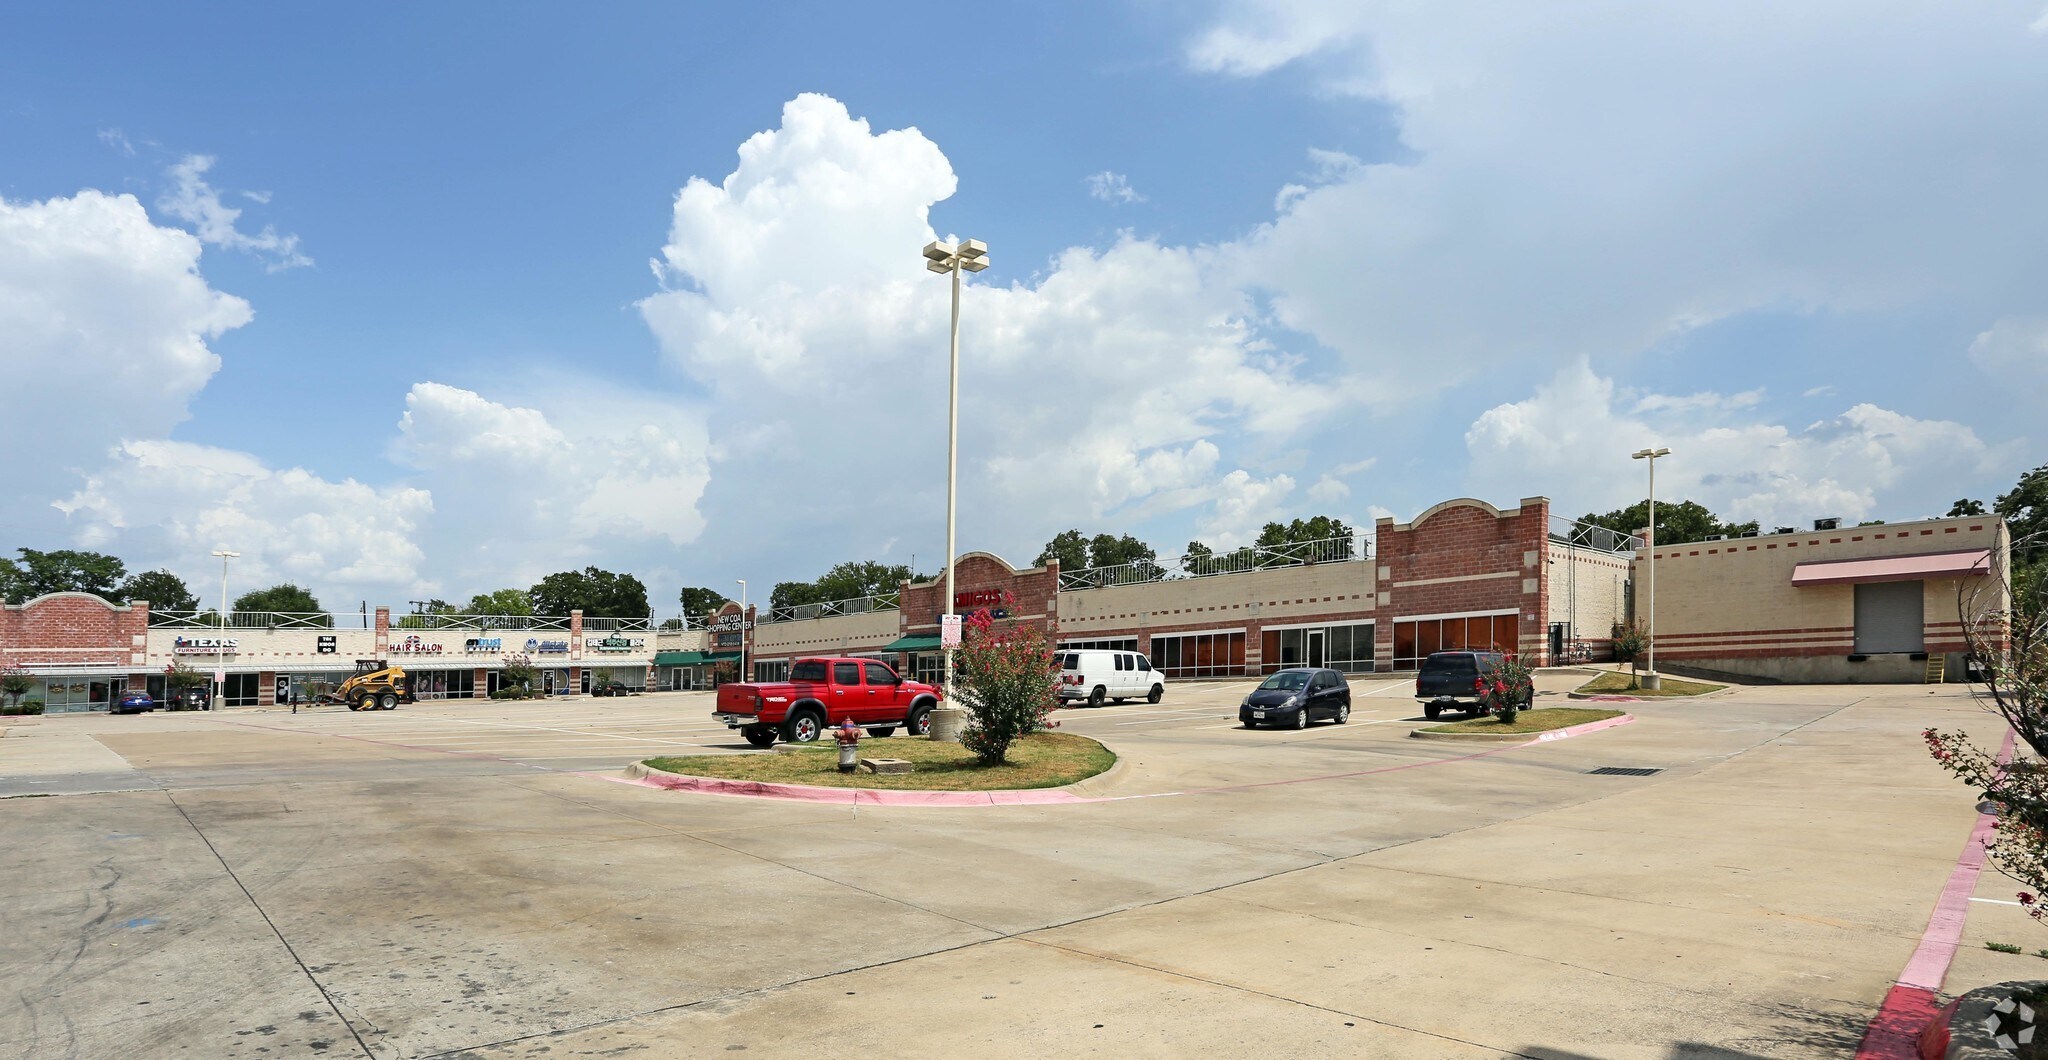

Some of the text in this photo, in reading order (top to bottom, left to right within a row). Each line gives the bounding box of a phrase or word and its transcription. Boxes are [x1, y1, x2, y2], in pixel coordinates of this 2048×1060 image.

[718, 614, 741, 624] NEW COA
[706, 621, 752, 632] SHOPPING CENER
[189, 638, 239, 646] TEXAS
[390, 643, 443, 651] HAIR SALON
